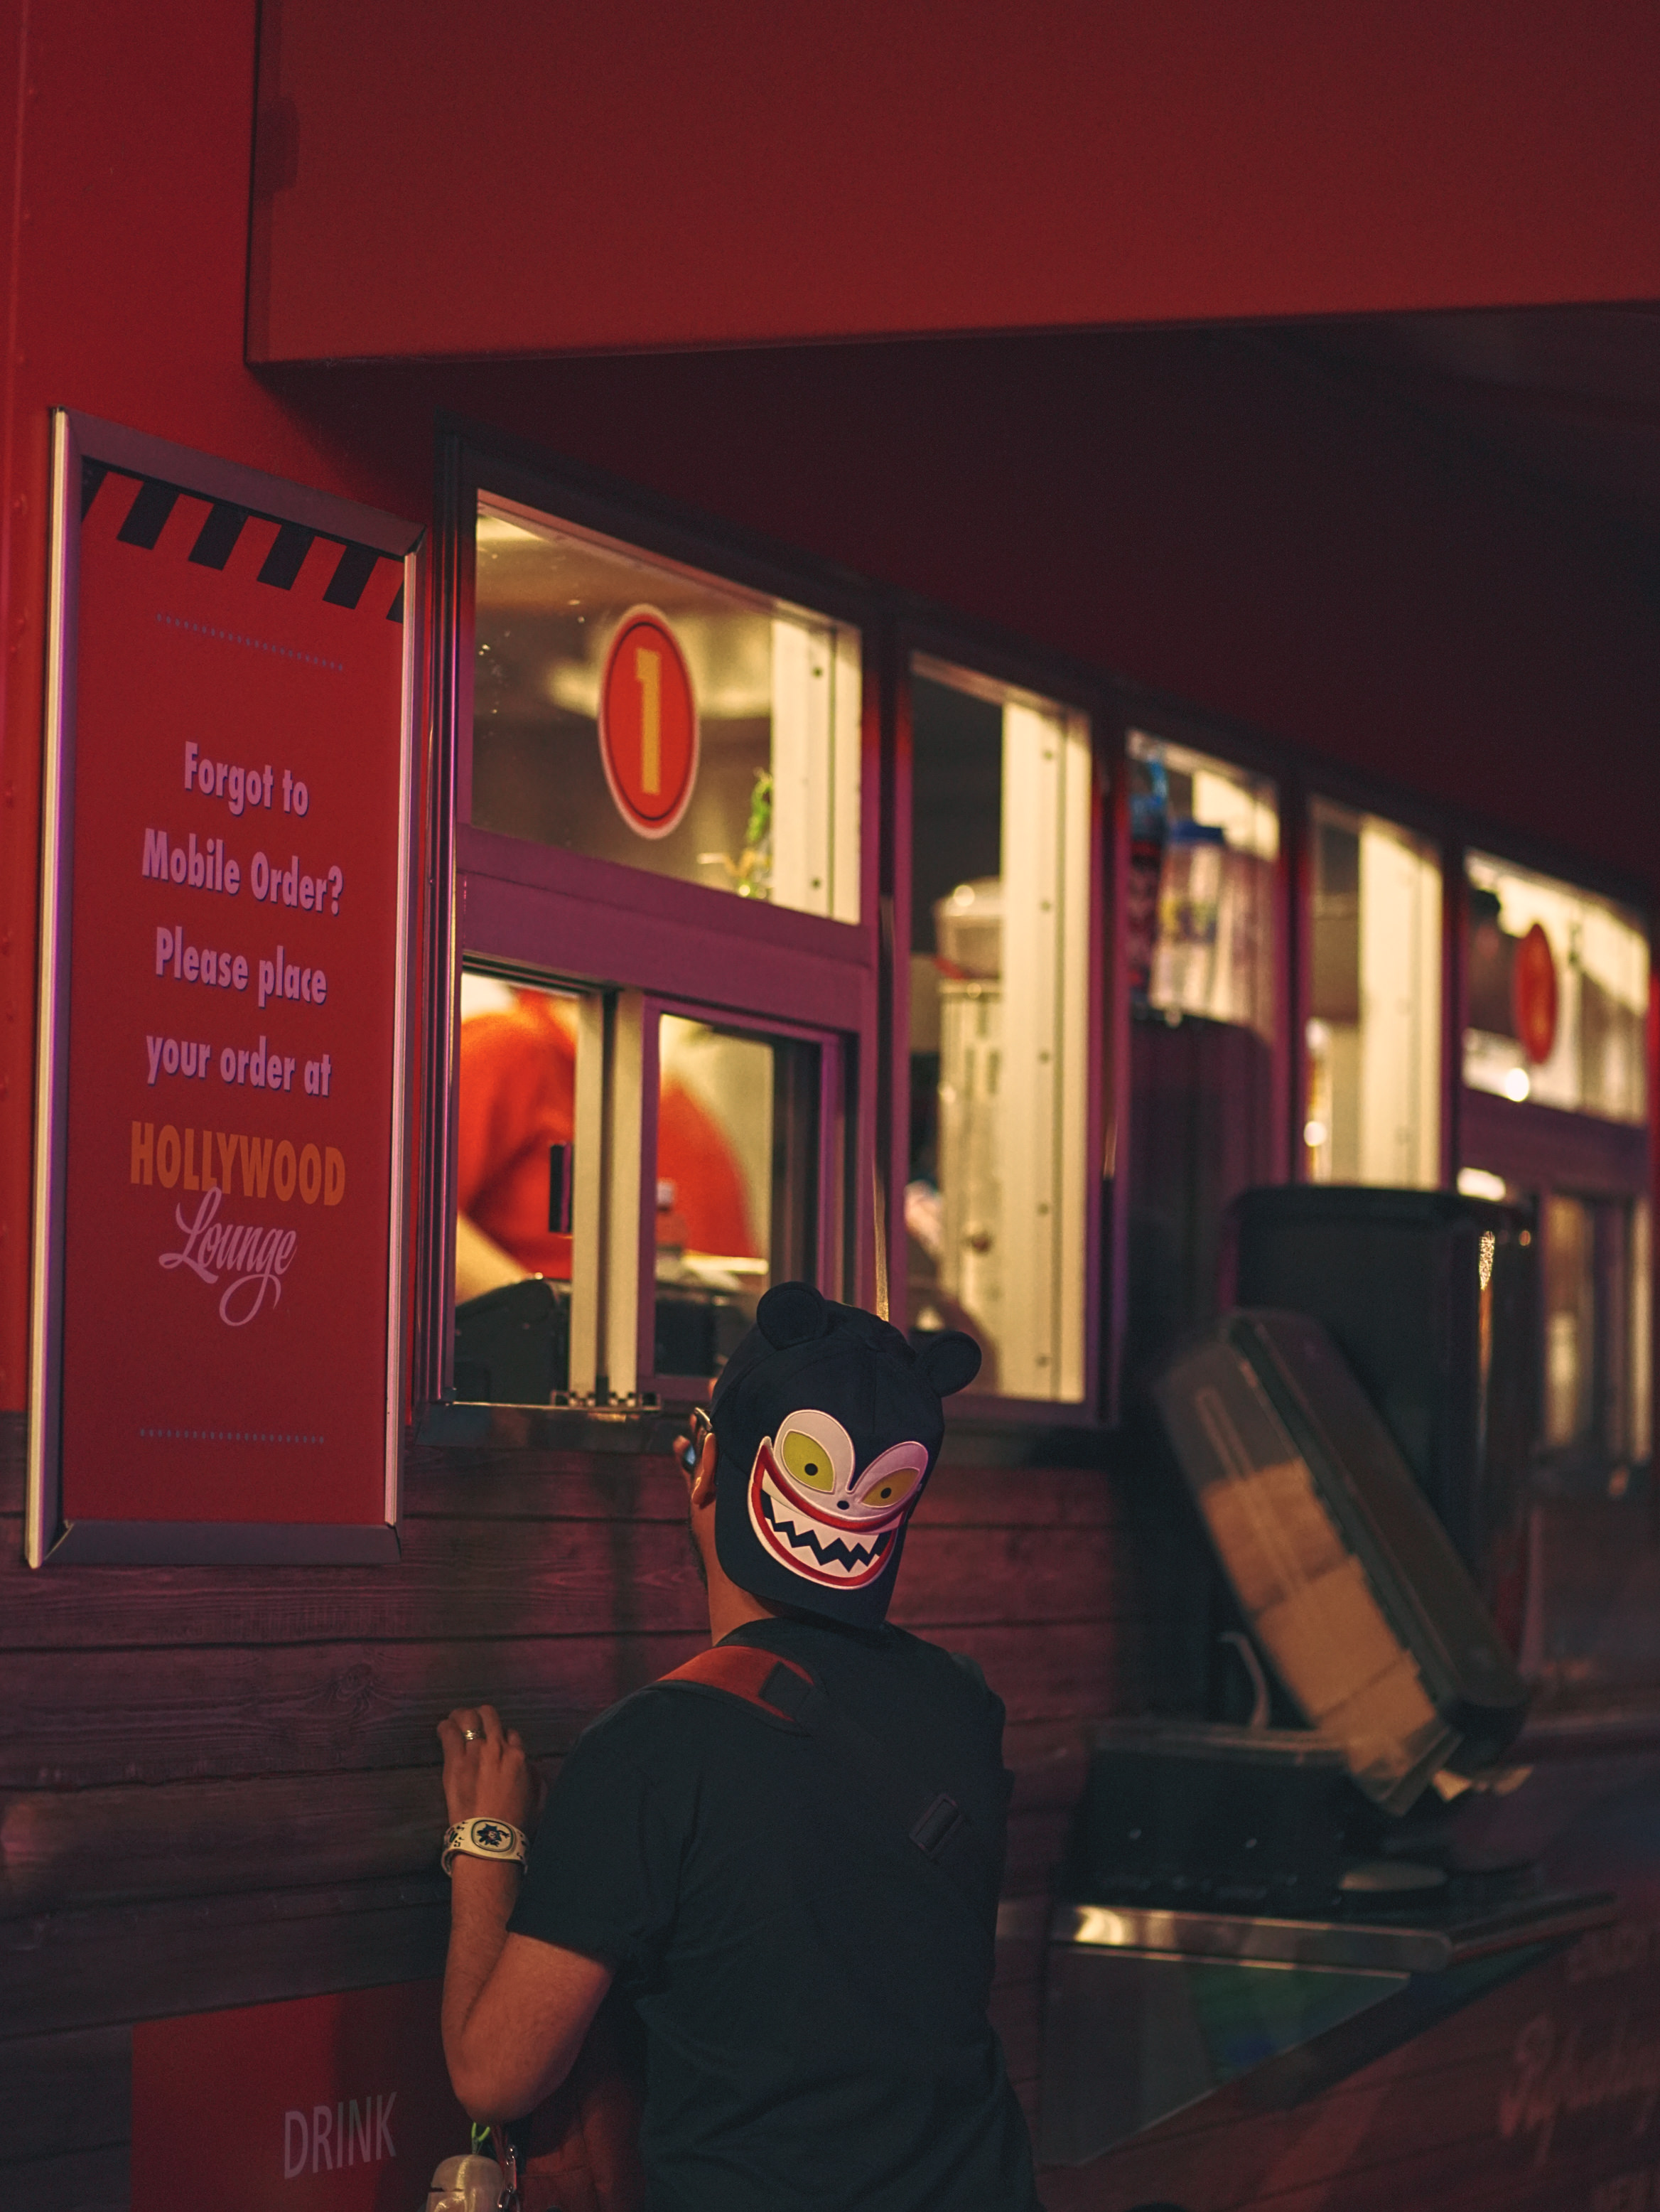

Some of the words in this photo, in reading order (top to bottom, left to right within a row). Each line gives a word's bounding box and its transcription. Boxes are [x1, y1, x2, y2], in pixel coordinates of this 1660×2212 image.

[636, 647, 661, 794] 1
[183, 740, 275, 817] Forgot
[281, 768, 310, 817] to
[141, 827, 242, 896] Mobile
[249, 851, 345, 916] Order?
[154, 924, 249, 992] Please
[257, 944, 328, 1009] place
[146, 1034, 212, 1085] your
[219, 1034, 296, 1092] order
[303, 1053, 333, 1097] at
[130, 1120, 346, 1206] HOLLYWOOD
[158, 1185, 298, 1328] Lounge
[284, 2091, 397, 2179] DRINK
